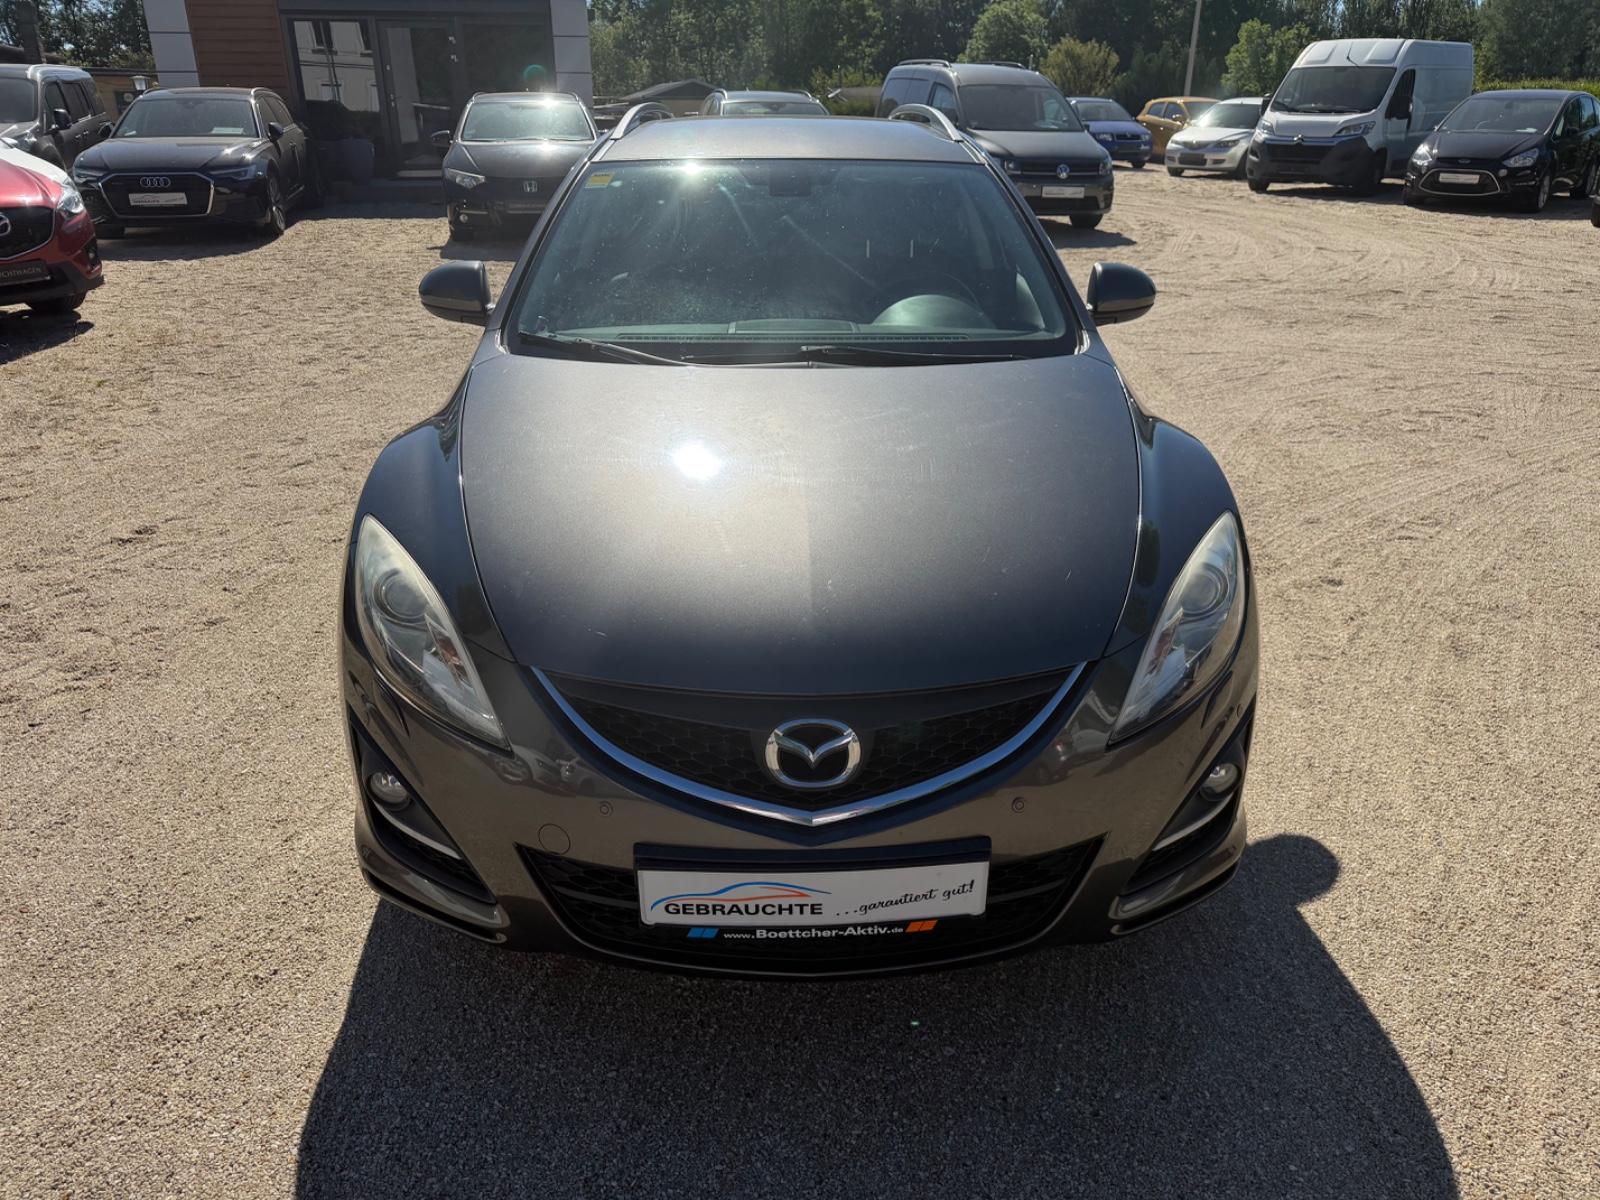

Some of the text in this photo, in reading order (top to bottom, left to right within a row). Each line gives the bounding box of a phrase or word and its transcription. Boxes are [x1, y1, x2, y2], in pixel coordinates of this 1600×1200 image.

[663, 903, 823, 916] GEBRAUCHTE
[942, 879, 975, 900] gut!
[723, 925, 904, 939] www.Boettcher-Aktiv.de
